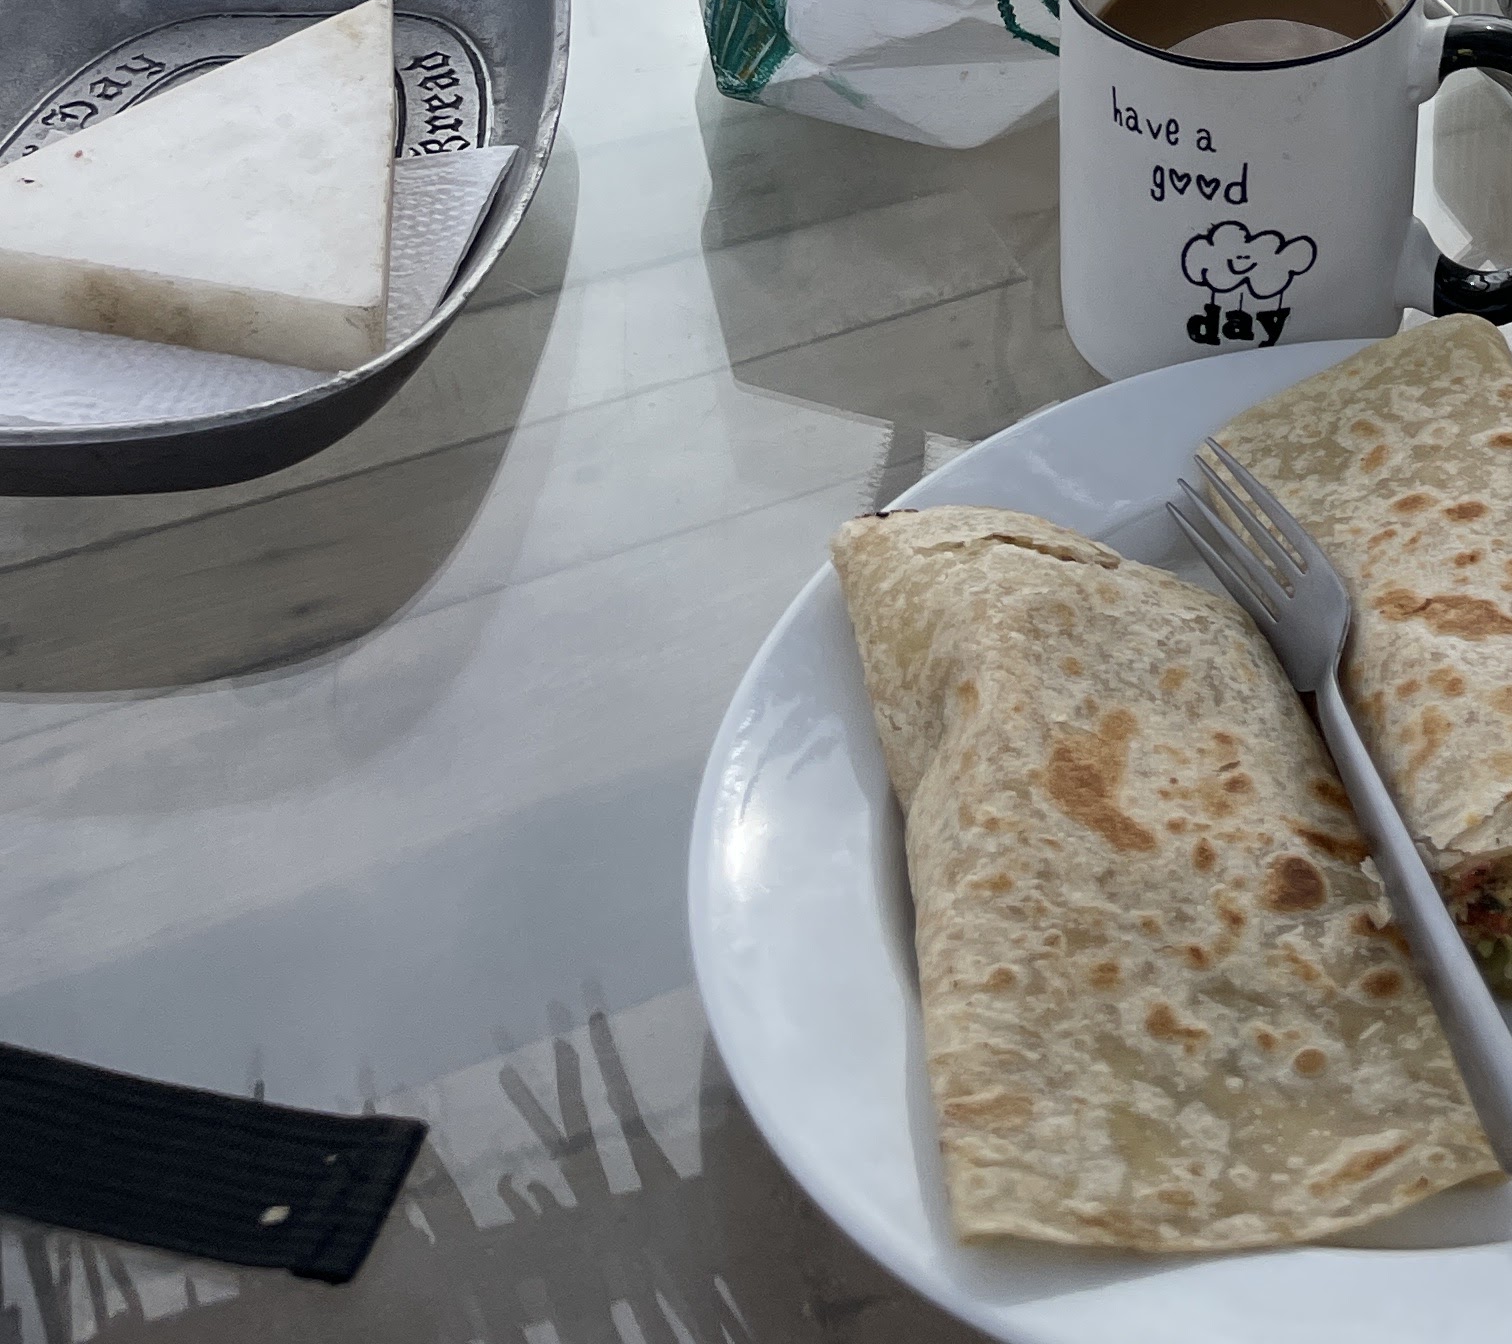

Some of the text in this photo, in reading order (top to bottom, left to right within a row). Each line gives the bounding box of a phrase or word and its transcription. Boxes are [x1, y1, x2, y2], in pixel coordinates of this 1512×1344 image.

[400, 51, 470, 157] Bread
[1112, 86, 1217, 153] have a
[1187, 303, 1290, 347] day
